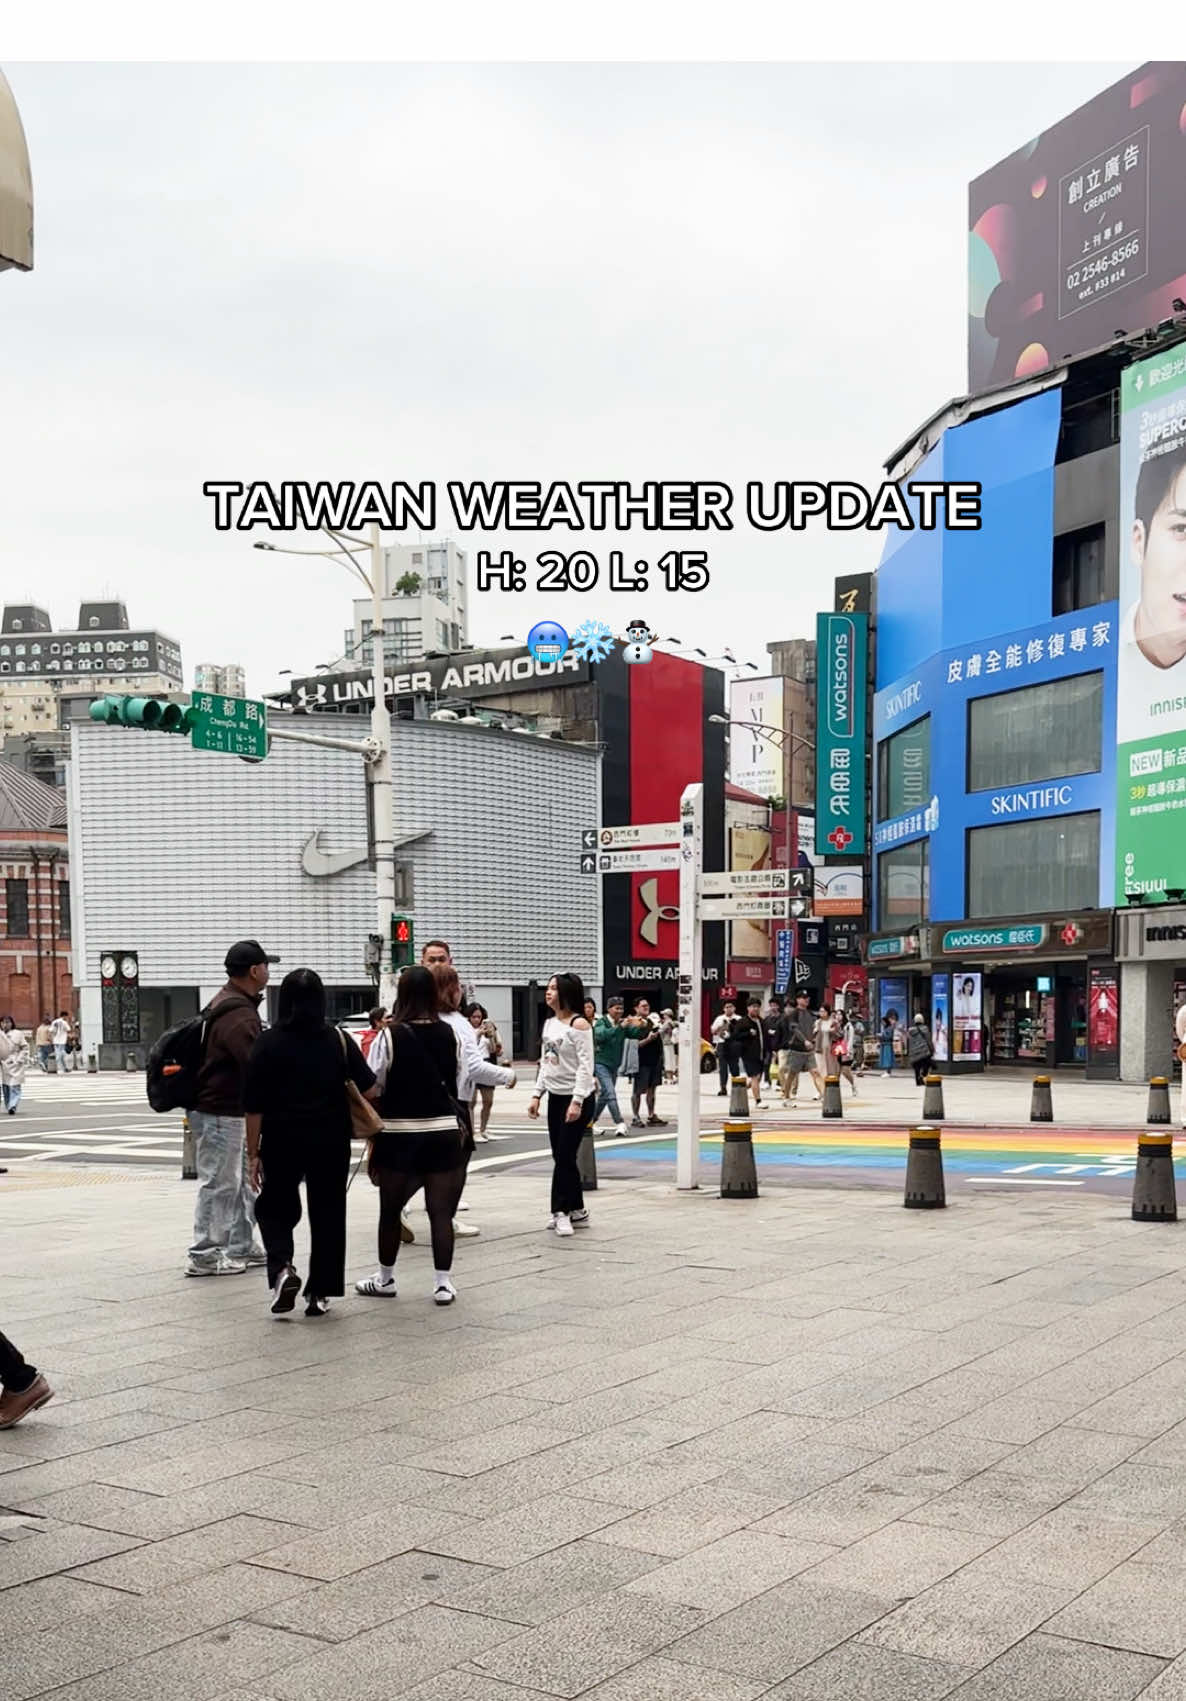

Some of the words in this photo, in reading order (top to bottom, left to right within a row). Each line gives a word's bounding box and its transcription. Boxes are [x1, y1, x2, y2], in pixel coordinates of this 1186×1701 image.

[1068, 143, 1140, 204] 創立廣告
[1083, 182, 1122, 213] CREATION
[1067, 272, 1080, 289] 02
[1081, 239, 1140, 283] 2546-8566
[947, 621, 1111, 684] 皮膚全能修復專家
[833, 633, 848, 723] watsons
[200, 696, 258, 720] 成都路
[885, 680, 921, 719] SKINTIFIC
[1132, 753, 1161, 771] NEW
[992, 786, 1072, 815] SKINTIFIC
[951, 933, 1003, 946] watsons
[616, 965, 662, 980] UNDER
